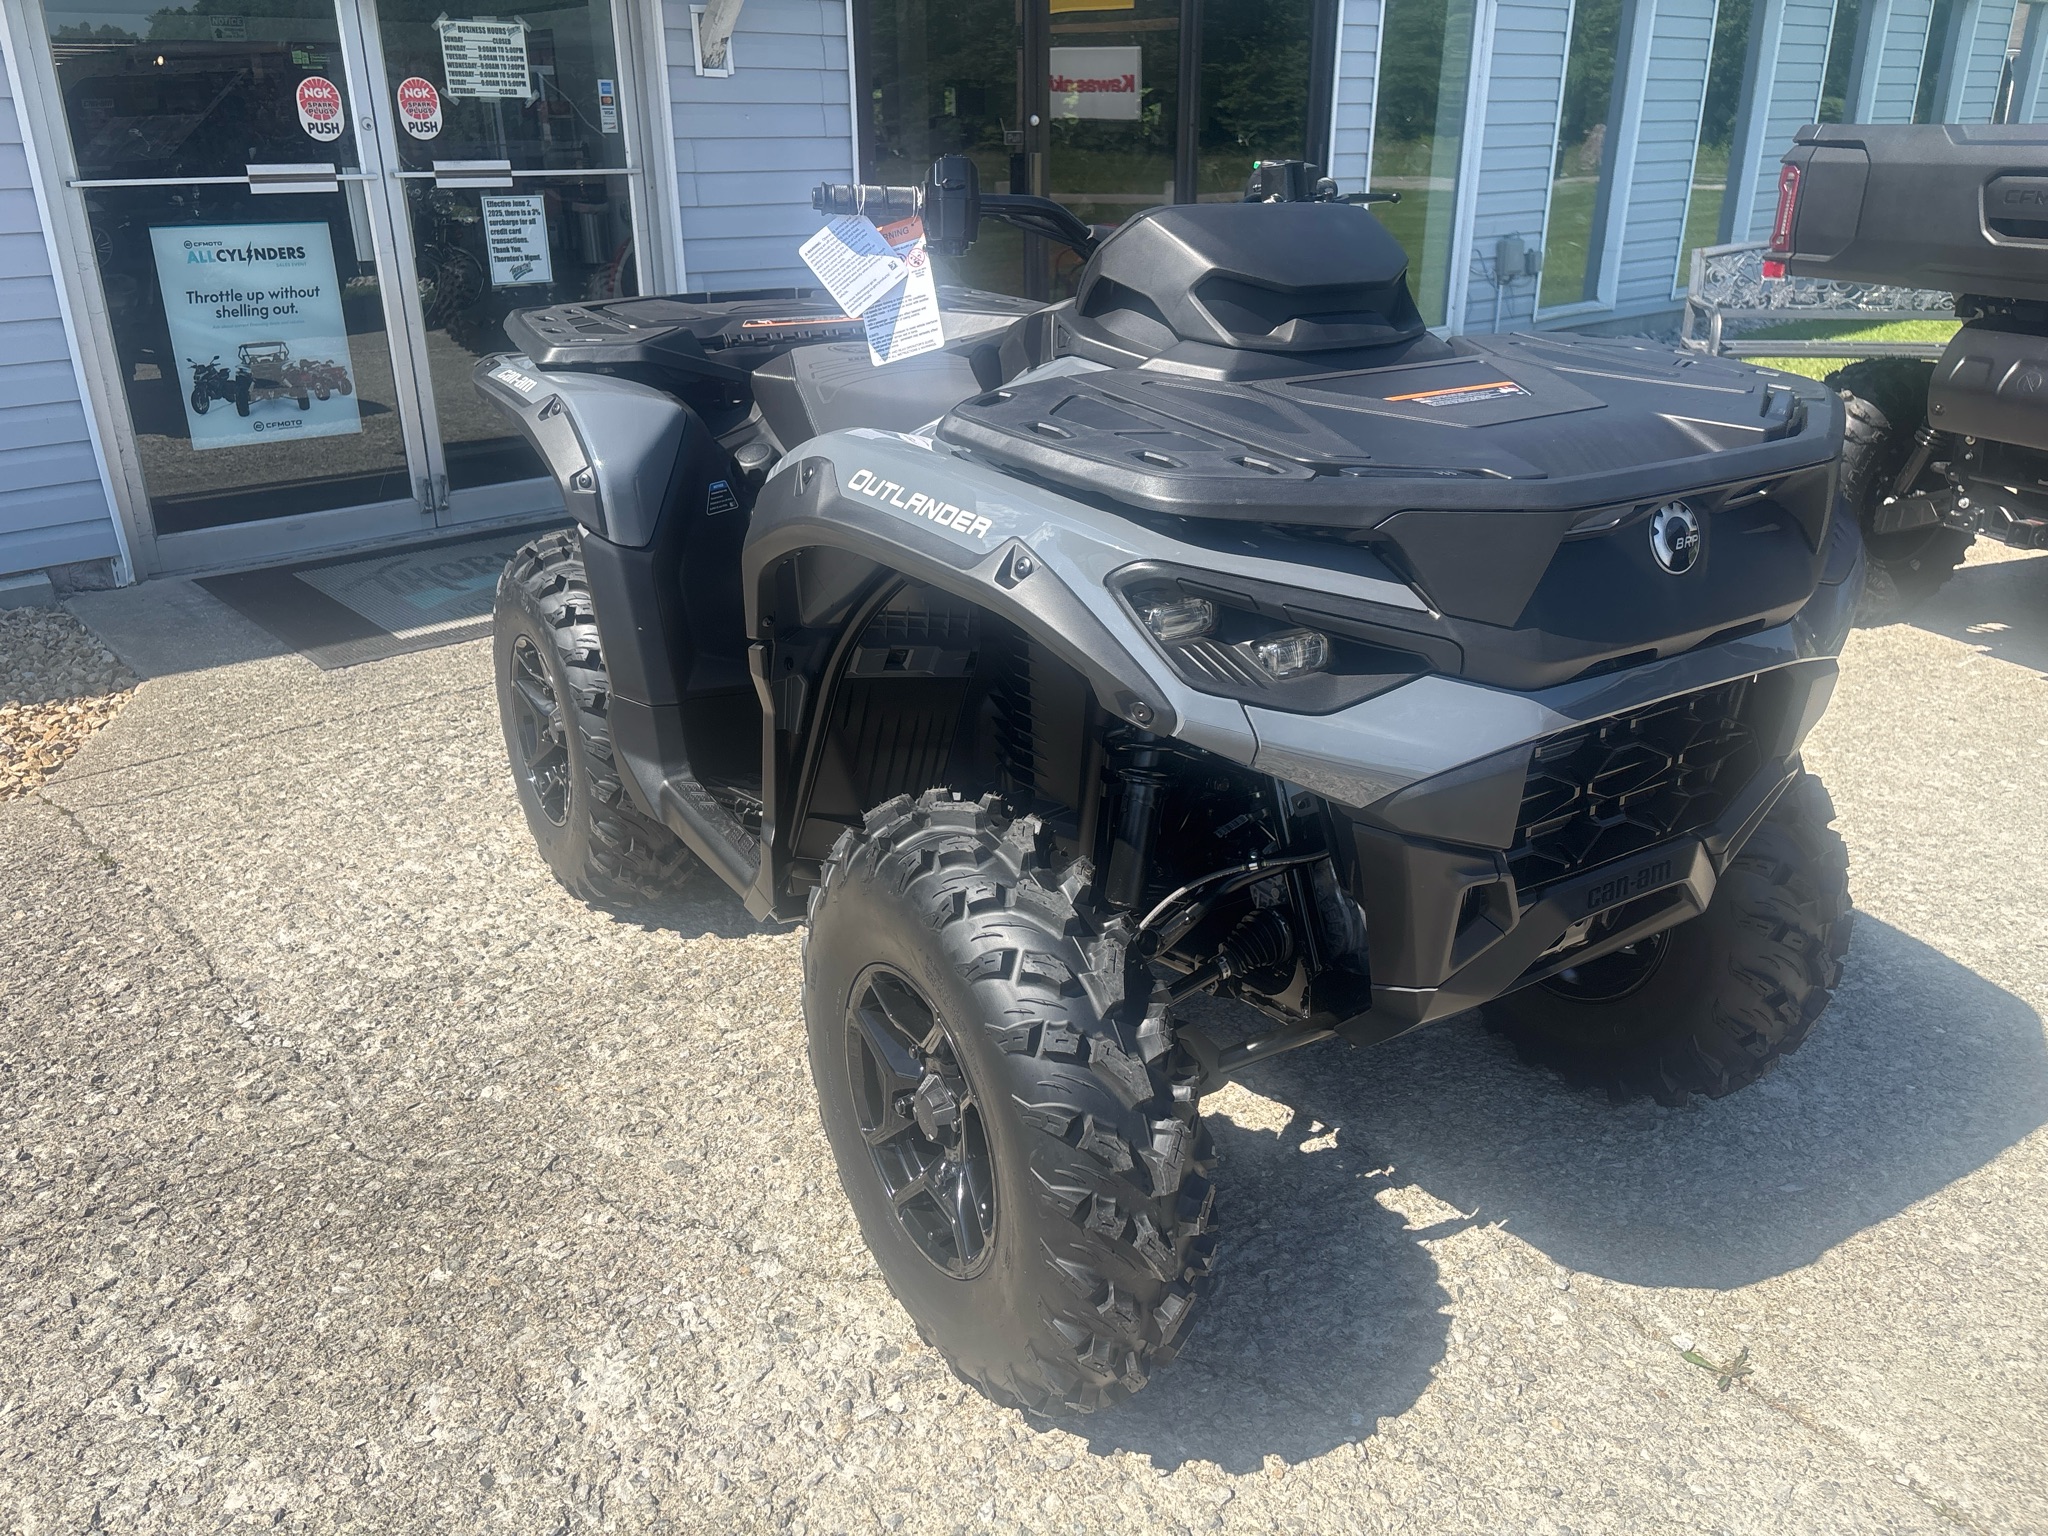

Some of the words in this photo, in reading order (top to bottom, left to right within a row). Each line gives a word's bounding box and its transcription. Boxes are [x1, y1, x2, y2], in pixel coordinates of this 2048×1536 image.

[213, 17, 242, 25] NOTICE
[458, 26, 486, 34] BUSINESS
[304, 88, 332, 98] NGK
[404, 88, 430, 98] NGK
[308, 122, 340, 134] PUSH
[408, 122, 438, 132] PUSH
[186, 289, 242, 304] Throttle
[247, 291, 264, 303] up
[268, 286, 320, 300] without
[216, 304, 268, 319] shelling
[273, 303, 298, 315] out.
[497, 370, 538, 392] can-am
[266, 420, 302, 429] CFMOTO
[848, 469, 992, 538] OUTLANDER
[1676, 534, 1698, 550] BRP
[1588, 860, 1672, 909] can-am
